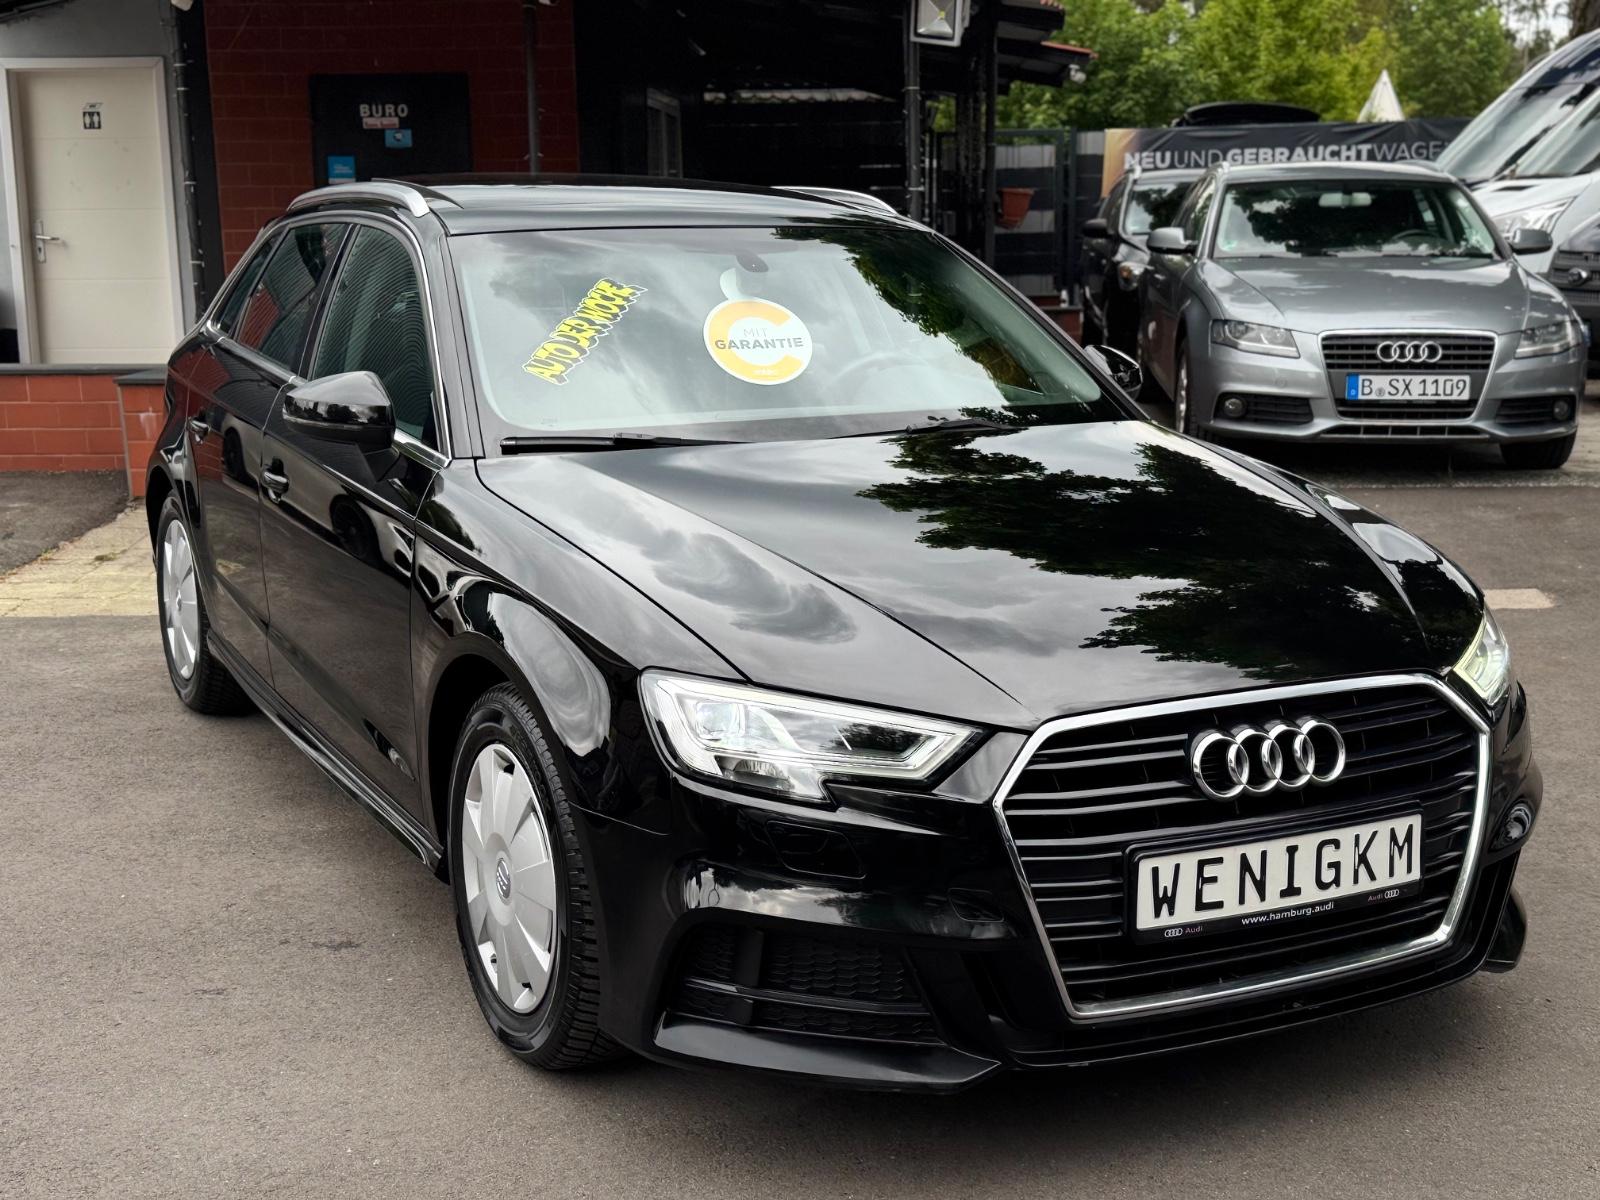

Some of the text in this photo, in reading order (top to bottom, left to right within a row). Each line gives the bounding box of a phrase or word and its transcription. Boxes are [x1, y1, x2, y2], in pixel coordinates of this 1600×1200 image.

[522, 278, 638, 385] AUTO DER WOCHE
[743, 327, 768, 338] MIT
[714, 337, 804, 350] GARANTIE
[1361, 378, 1373, 396] B
[1387, 378, 1413, 397] SX
[1417, 378, 1467, 397] 1109
[1151, 823, 1414, 919] WENIGKM
[1368, 892, 1384, 902] Audi
[1241, 901, 1335, 926] www.hamburg.audi
[1185, 925, 1203, 935] Audi
